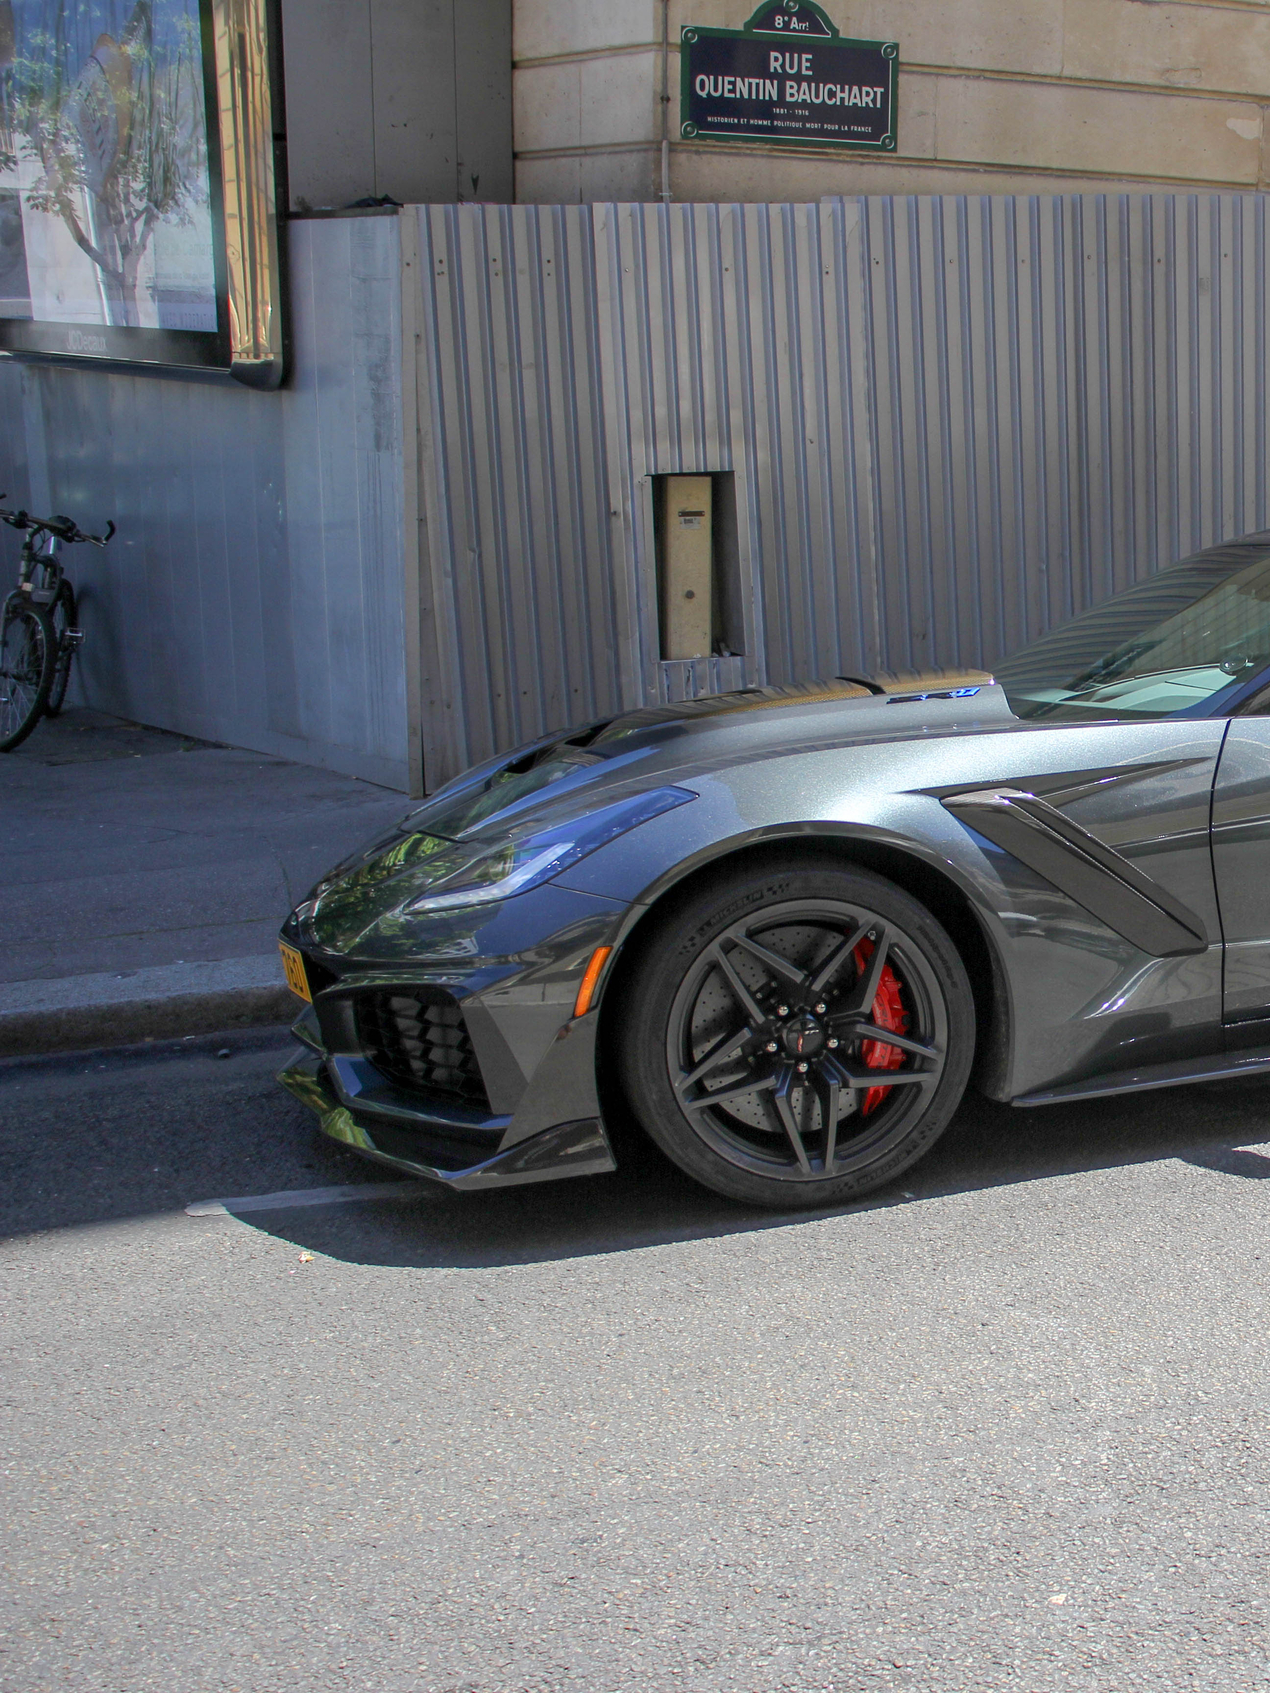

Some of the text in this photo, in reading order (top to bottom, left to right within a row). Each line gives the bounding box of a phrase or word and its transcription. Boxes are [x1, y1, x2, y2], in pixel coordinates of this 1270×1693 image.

[770, 51, 813, 76] RUE
[695, 73, 884, 108] QUENTIN BAUCHART
[707, 116, 738, 124] HISTORIEN
[750, 118, 771, 126] HOMME
[774, 120, 803, 128] POLITIQUE
[824, 123, 838, 131] POUR
[851, 125, 872, 133] FRANCE
